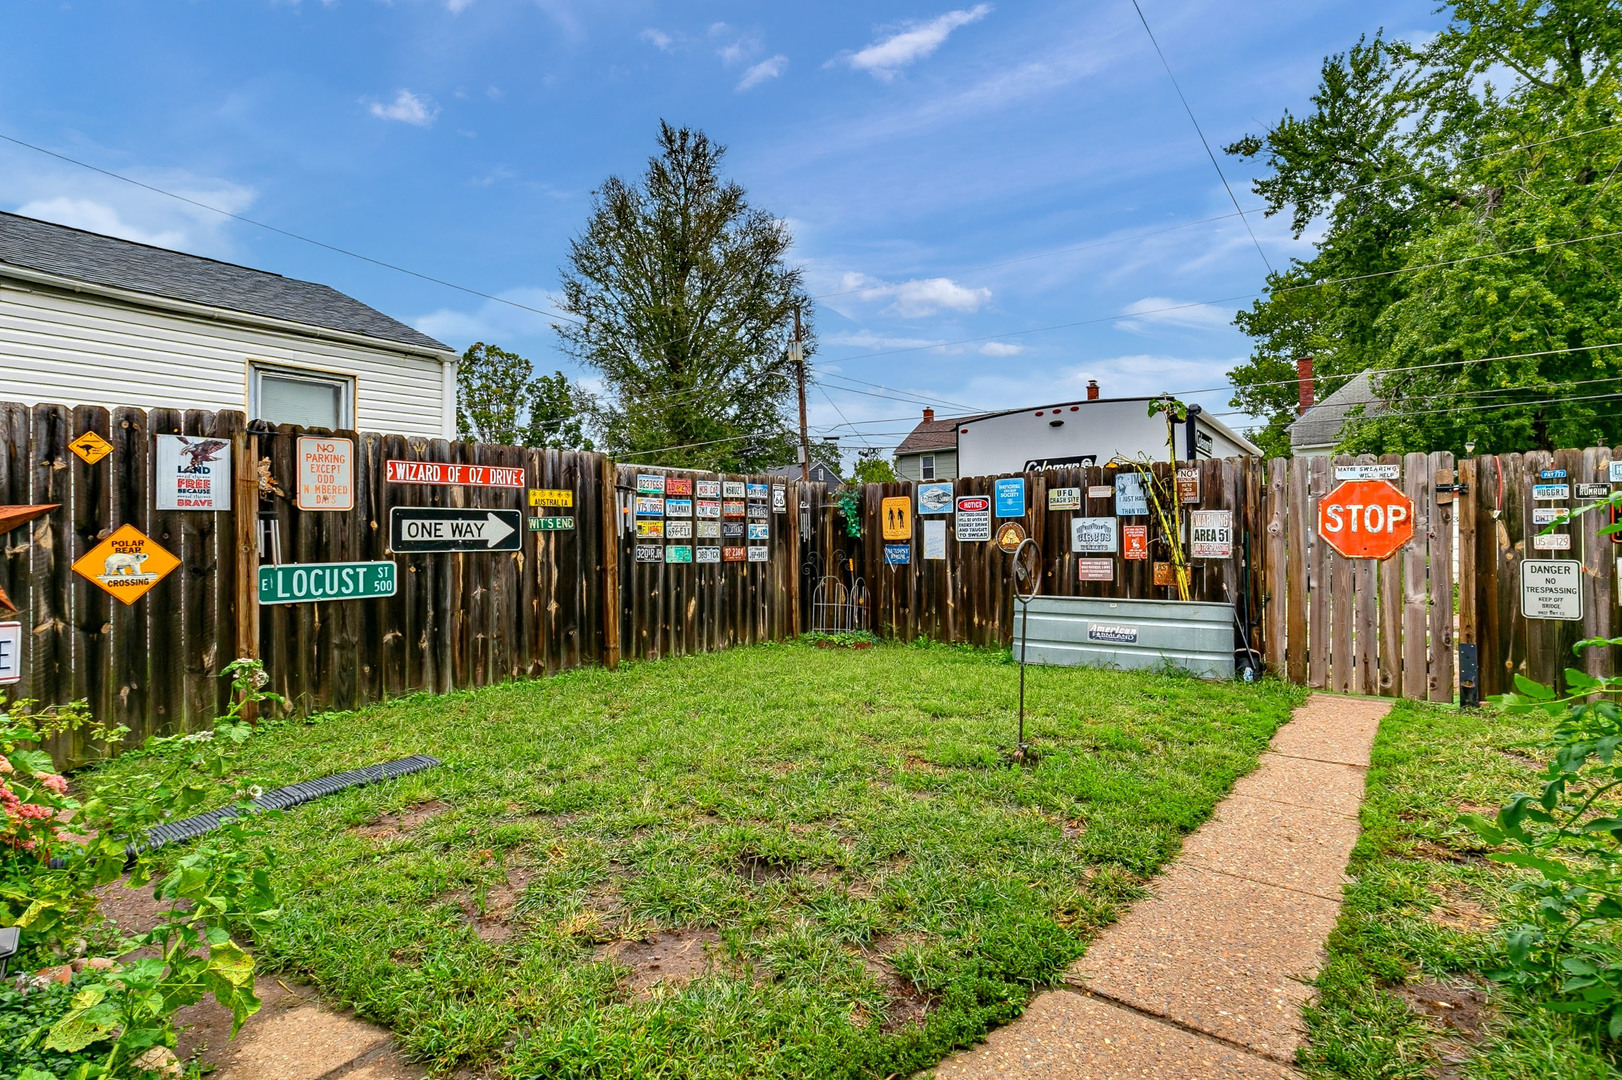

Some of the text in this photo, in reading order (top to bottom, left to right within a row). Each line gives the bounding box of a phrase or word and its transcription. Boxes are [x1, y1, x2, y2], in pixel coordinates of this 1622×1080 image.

[316, 443, 335, 453] NO
[305, 453, 345, 464] PARKING
[177, 465, 211, 475] LAND
[310, 463, 341, 474] EXCEPT
[395, 462, 519, 485] WIZARD OF OZ DRIVE
[317, 474, 335, 484] ODD
[1181, 470, 1193, 478] NO
[177, 478, 211, 489] FREE
[303, 485, 348, 495] NMBERED
[1056, 489, 1073, 497] UFO
[177, 499, 213, 507] BRAVE
[316, 494, 337, 505] DAYS
[534, 498, 568, 506] AUSTRALIA
[775, 496, 784, 504] 66
[963, 501, 983, 509] NOTICE
[528, 518, 574, 529] WIT'S END
[1324, 503, 1408, 534] STOP
[407, 522, 485, 538] ONE WAY
[1077, 532, 1111, 542] CIRCUS
[1194, 529, 1229, 542] AREA 51
[111, 540, 145, 548] POLAR
[1535, 536, 1569, 546] US 129
[1530, 565, 1571, 575] DANGER
[107, 578, 150, 588] CROSSING
[261, 566, 390, 598] E LOCUST ST
[374, 580, 393, 592] 500
[1545, 577, 1557, 585] NO
[1526, 586, 1578, 595] TRESPASSING
[1090, 623, 1137, 635] American
